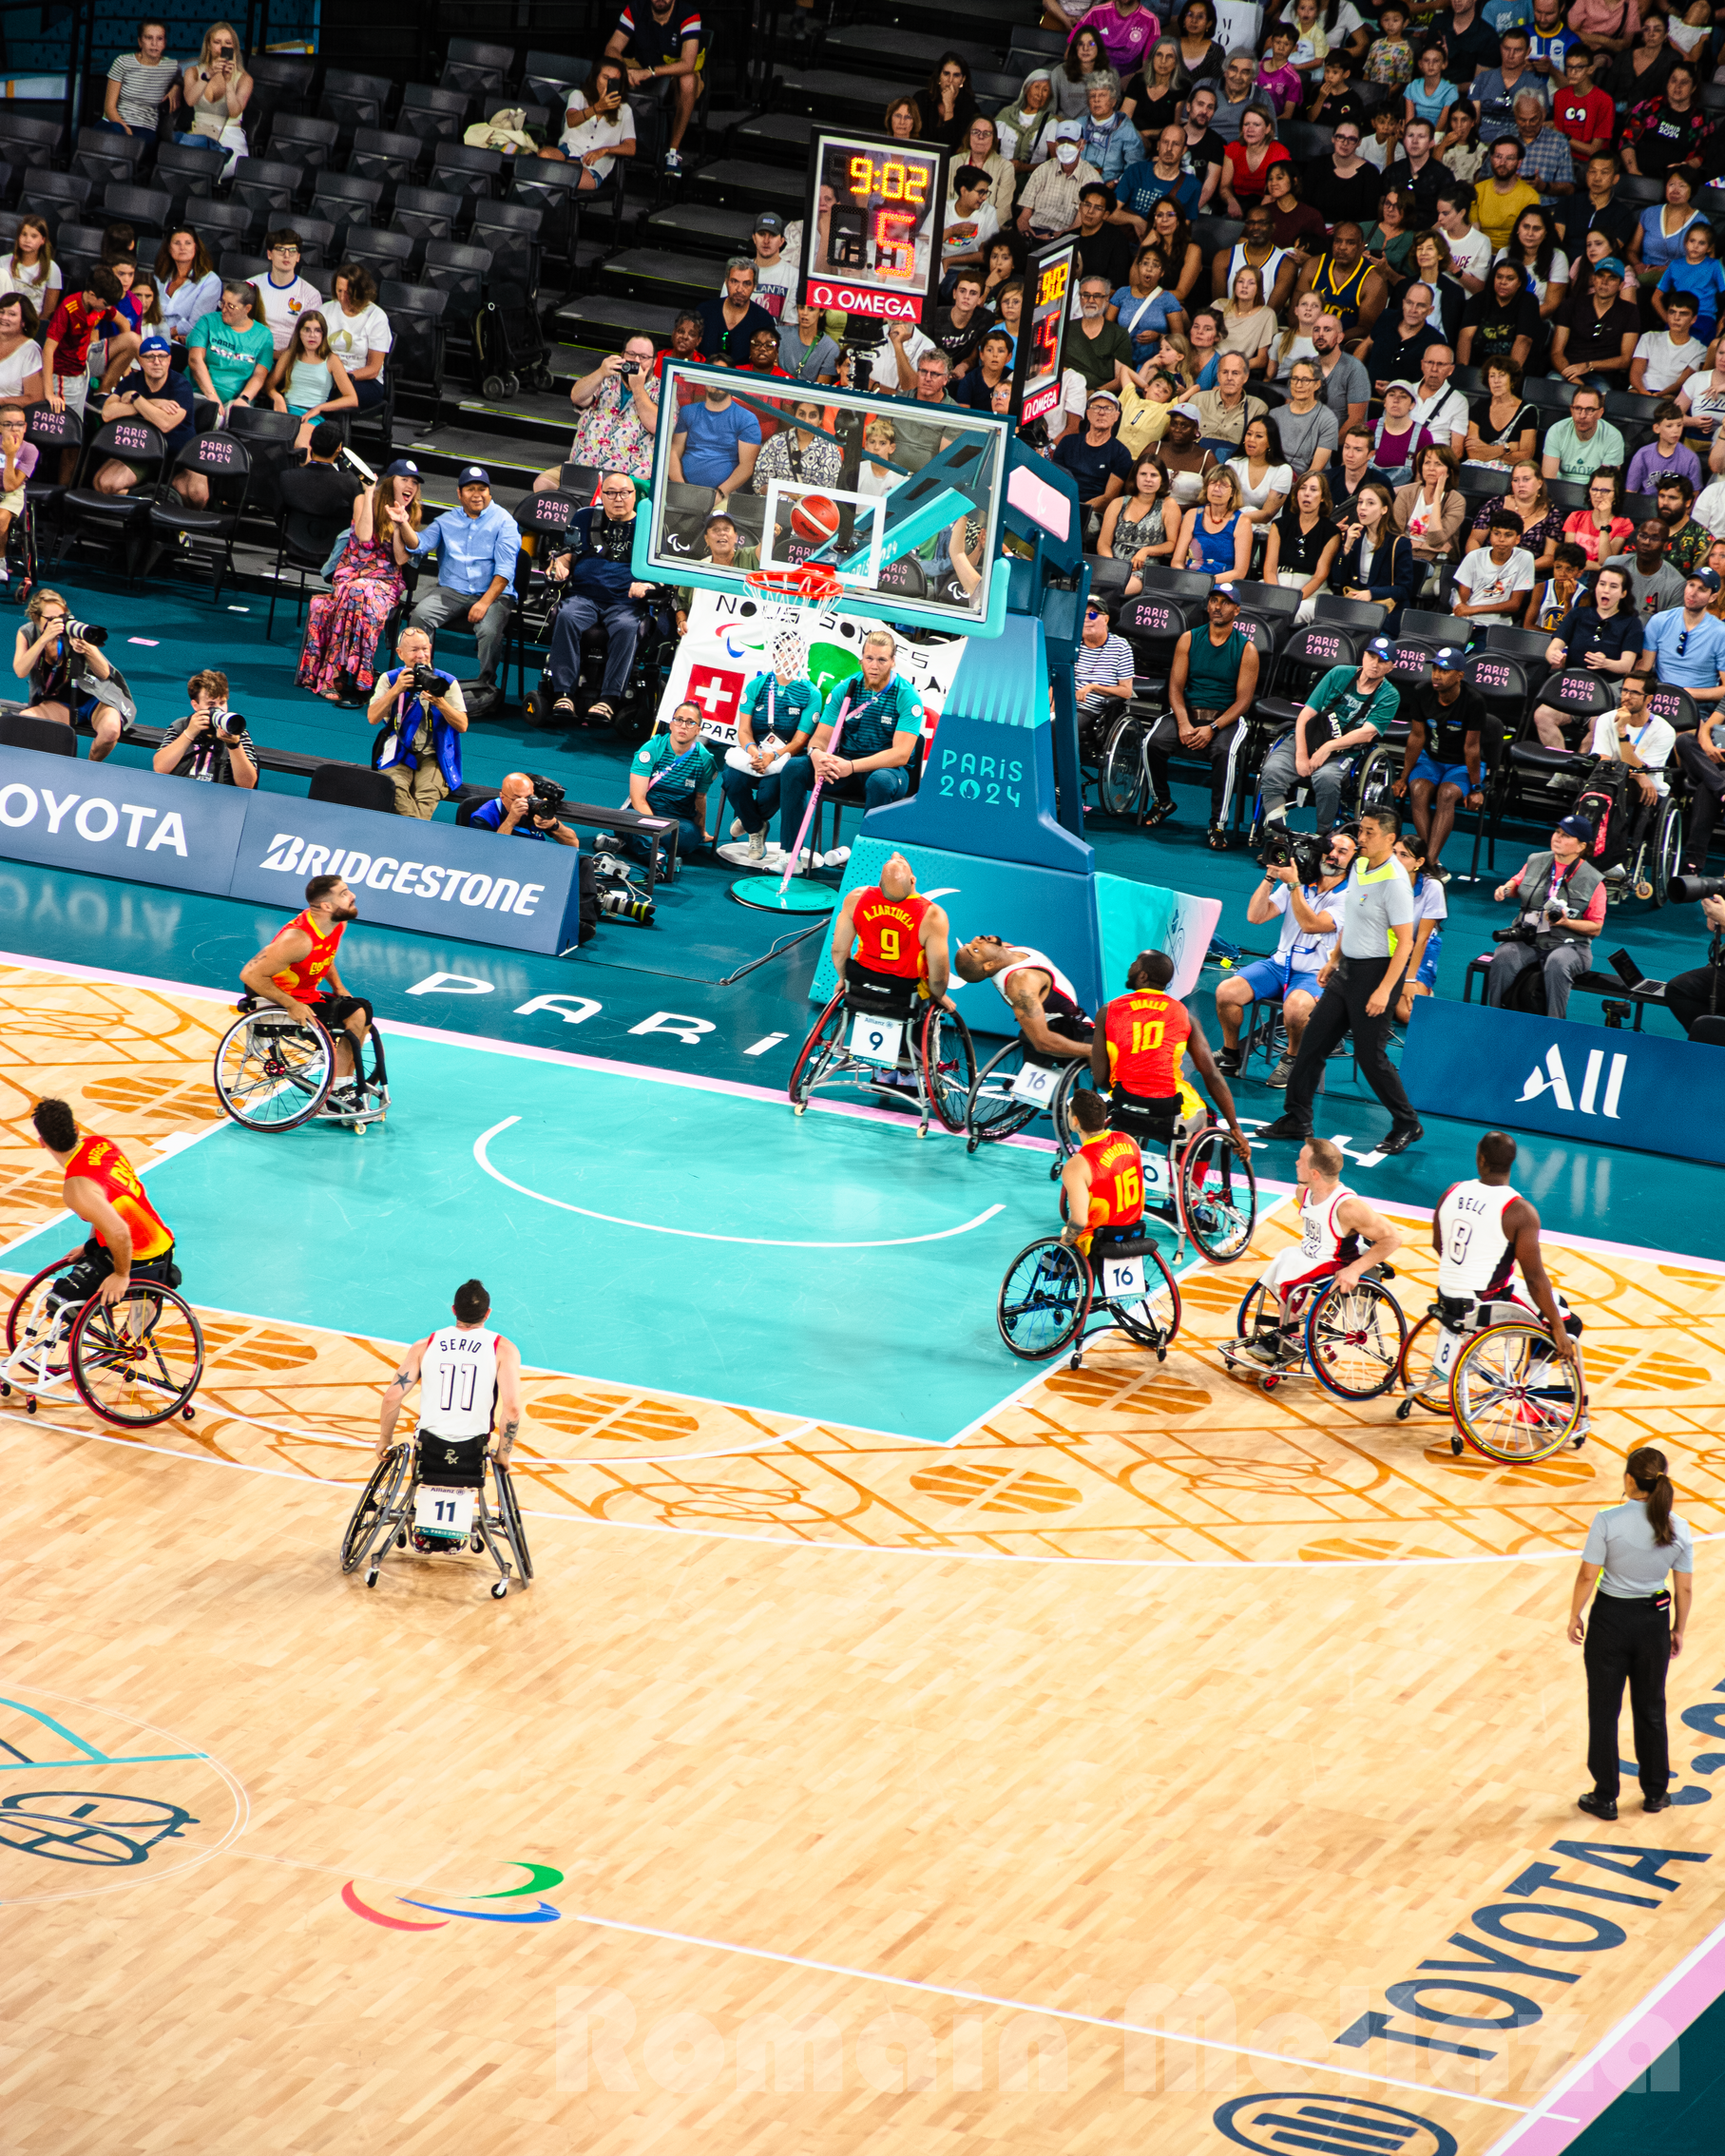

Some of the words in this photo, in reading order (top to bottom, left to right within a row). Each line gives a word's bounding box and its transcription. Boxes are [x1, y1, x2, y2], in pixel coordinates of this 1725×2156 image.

[850, 156, 929, 202] 9:02
[874, 208, 917, 279] 5
[837, 290, 917, 319] OMEGA
[1031, 389, 1058, 416] OMEGA
[31, 420, 64, 435] 2024
[114, 434, 146, 449] 2024
[199, 450, 232, 464] 2024
[535, 509, 568, 524] 2024
[883, 563, 909, 575] ARIS
[715, 594, 800, 625] NOUS
[819, 610, 930, 669] SOMES
[1135, 615, 1168, 630] 2024
[1233, 620, 1256, 634] ARIS
[1305, 645, 1337, 659] 2024
[1475, 673, 1508, 688] 2024
[1560, 687, 1593, 703] 2024
[1655, 693, 1681, 706] ARIS
[938, 775, 1021, 808] 2024
[259, 833, 546, 917] BRIDGESTONE
[880, 928, 900, 961] 9
[1128, 999, 1169, 1011] DIALLO
[869, 1031, 884, 1051] 9
[1131, 1020, 1166, 1054] 10
[1025, 1071, 1046, 1091] 16
[1114, 1165, 1140, 1213] 16
[1457, 1196, 1486, 1216] BELL
[1447, 1218, 1473, 1265] 8
[1113, 1265, 1134, 1287] 16
[439, 1338, 483, 1354] SERIO
[1440, 1342, 1450, 1364] 8
[439, 1362, 478, 1413] 11
[434, 1499, 457, 1523] 11
[1332, 1838, 1714, 2062] TOYOTA
